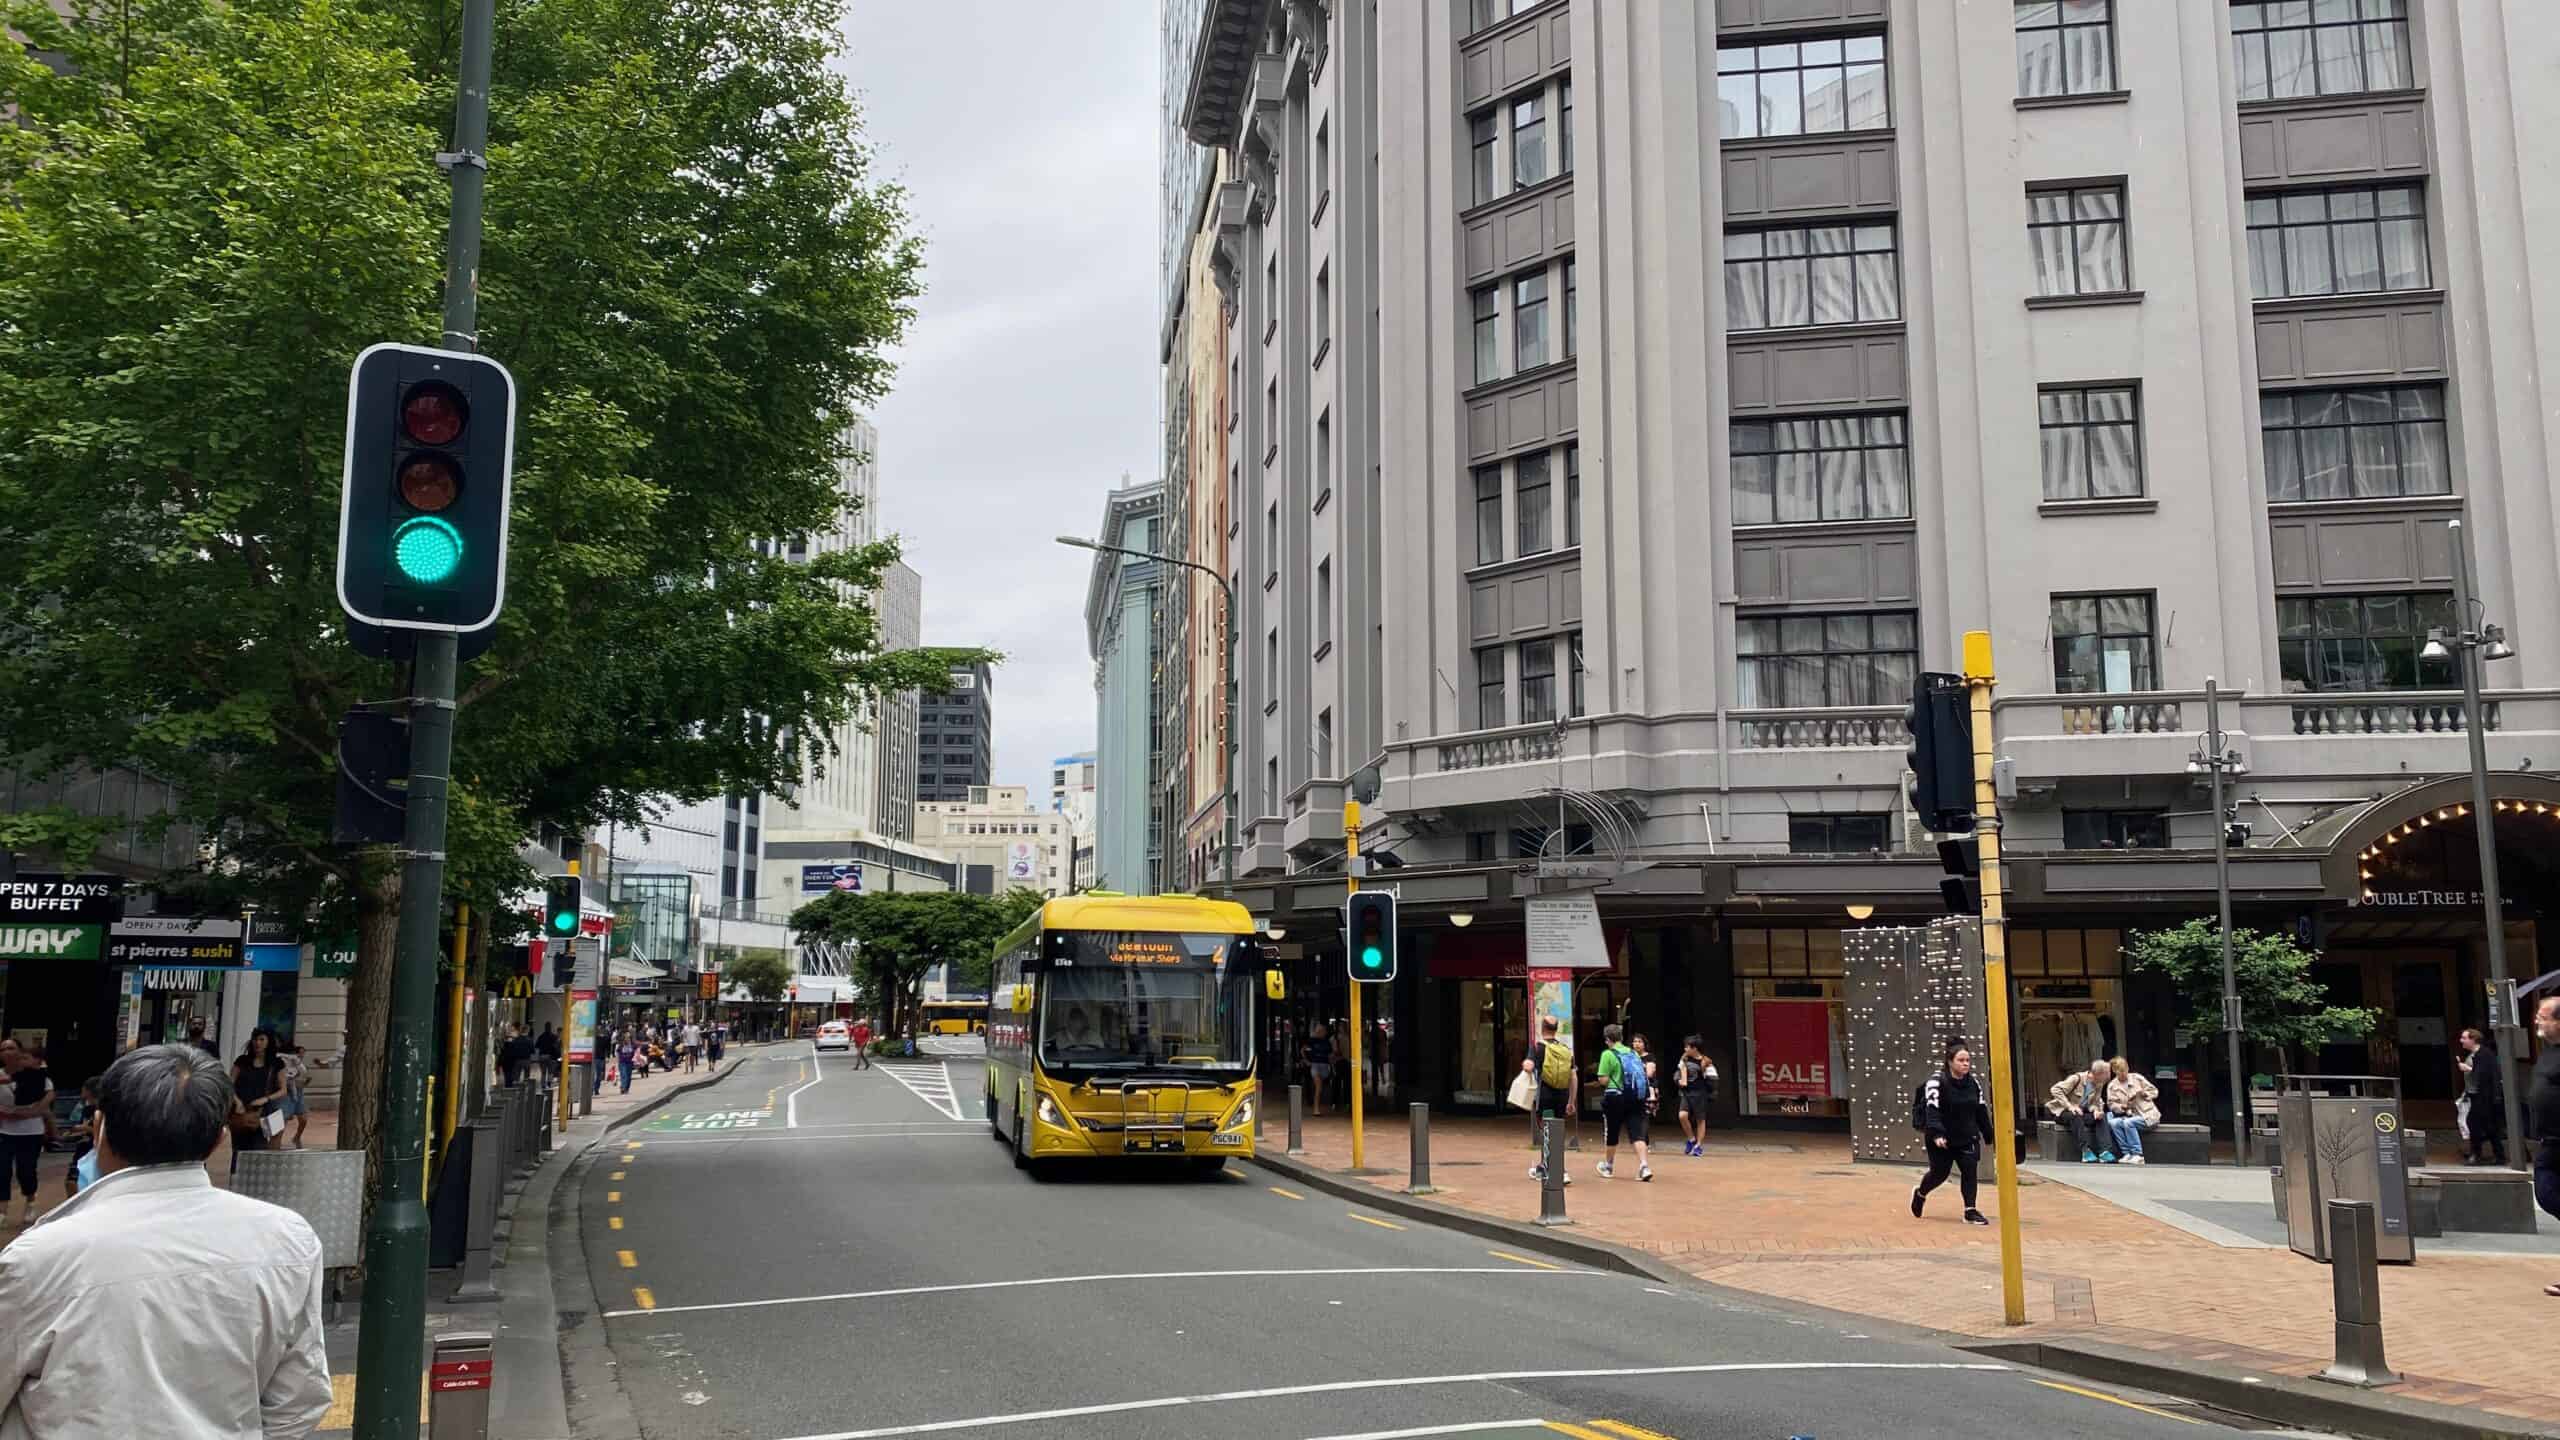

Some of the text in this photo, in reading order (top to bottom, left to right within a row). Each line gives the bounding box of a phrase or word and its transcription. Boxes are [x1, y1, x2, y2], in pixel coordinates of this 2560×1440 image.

[44, 884, 56, 895] 7
[62, 884, 108, 896] DAYS
[10, 898, 82, 911] BUFFET
[125, 921, 153, 929] OPEN
[111, 945, 126, 956] st
[129, 942, 188, 960] pierres
[191, 944, 233, 958] sushi
[1212, 944, 1224, 964] 2
[1504, 961, 1528, 976] see
[1761, 1063, 1826, 1083] SALE
[1780, 1101, 1809, 1113] seed
[681, 1110, 773, 1121] LANE
[680, 1119, 761, 1129] BUS
